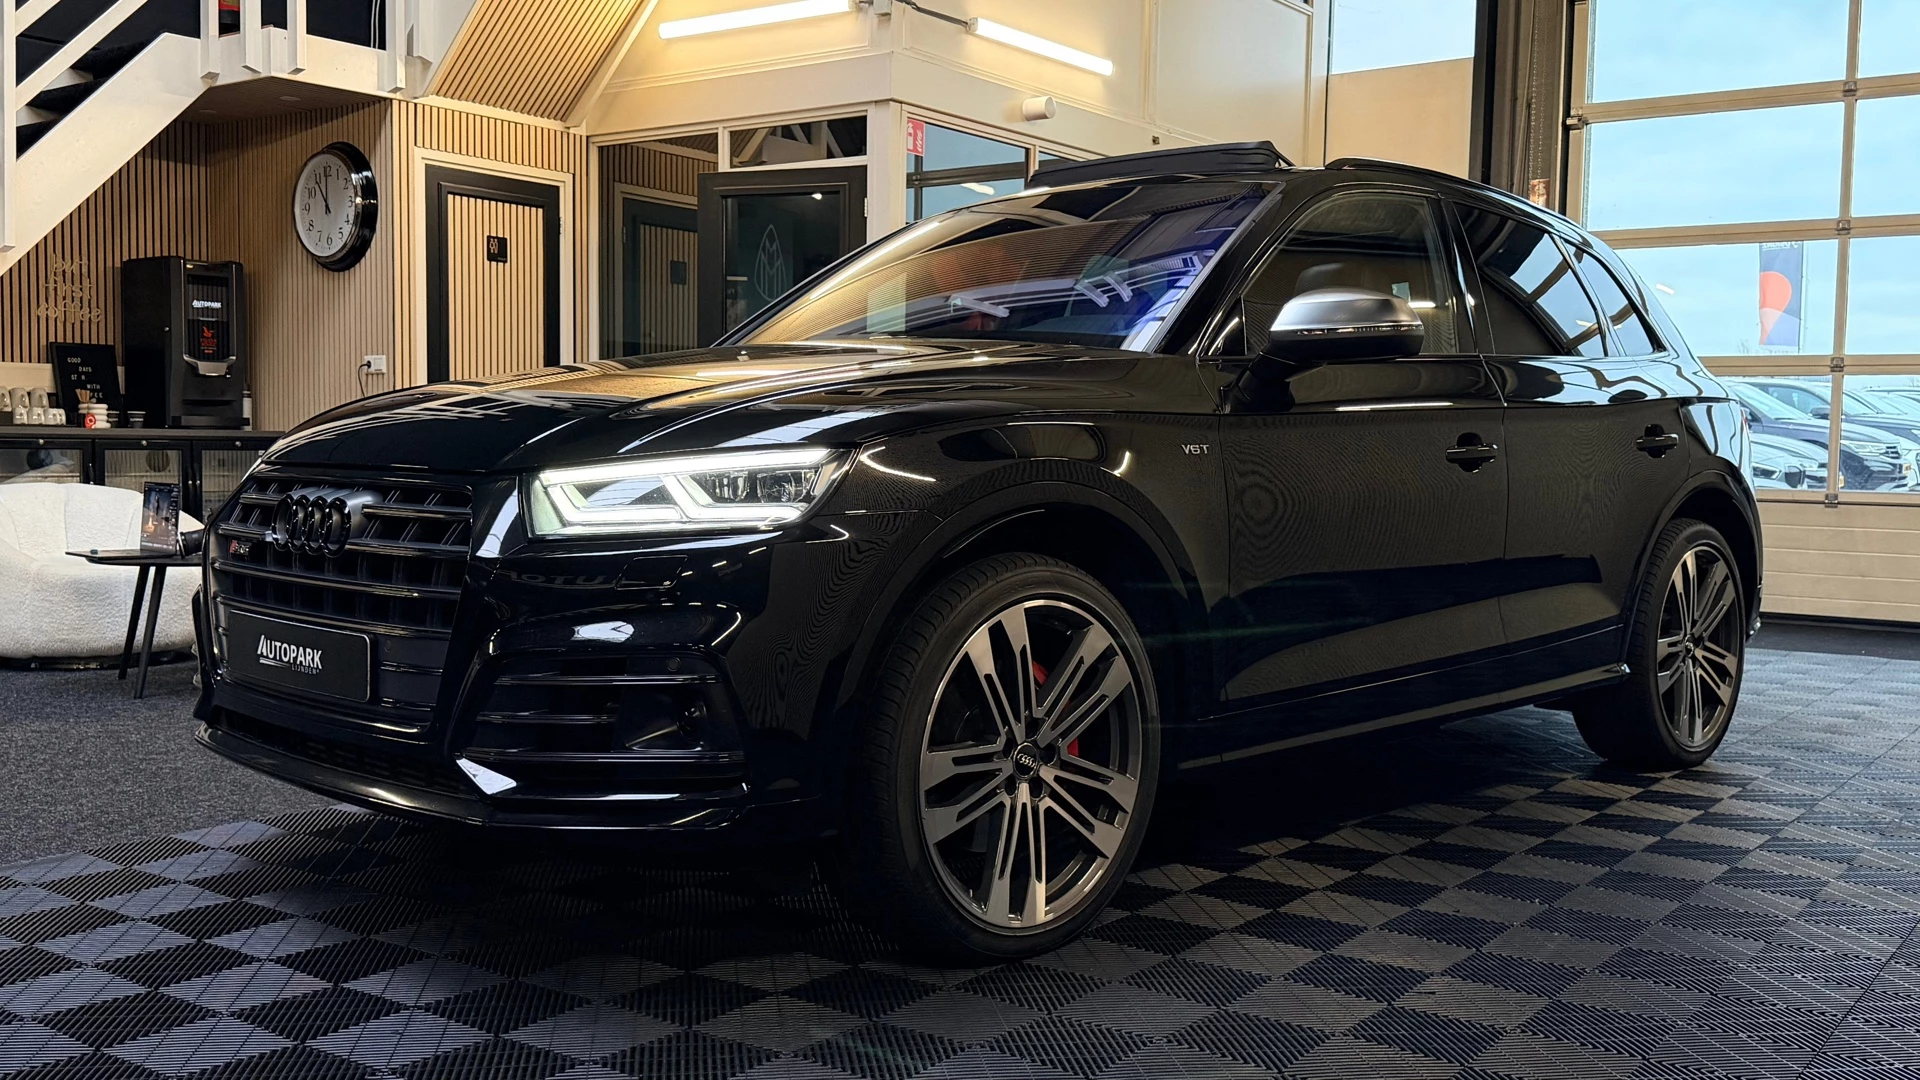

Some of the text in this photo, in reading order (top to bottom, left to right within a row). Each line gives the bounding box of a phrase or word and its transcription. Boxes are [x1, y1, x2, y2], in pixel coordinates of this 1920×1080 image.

[323, 165, 332, 177] 12
[314, 172, 321, 184] 11
[343, 178, 349, 190] 2
[307, 187, 316, 199] 10
[348, 195, 353, 208] 3
[304, 203, 311, 215] 9
[308, 219, 315, 231] 8
[344, 213, 350, 226] 4
[317, 230, 322, 243] 7
[326, 233, 332, 246] 6
[338, 227, 343, 240] 5
[45, 275, 92, 298] first
[192, 299, 222, 309] AUTOPARK
[37, 301, 101, 324] coffee
[257, 634, 322, 669] AUTOPARK
